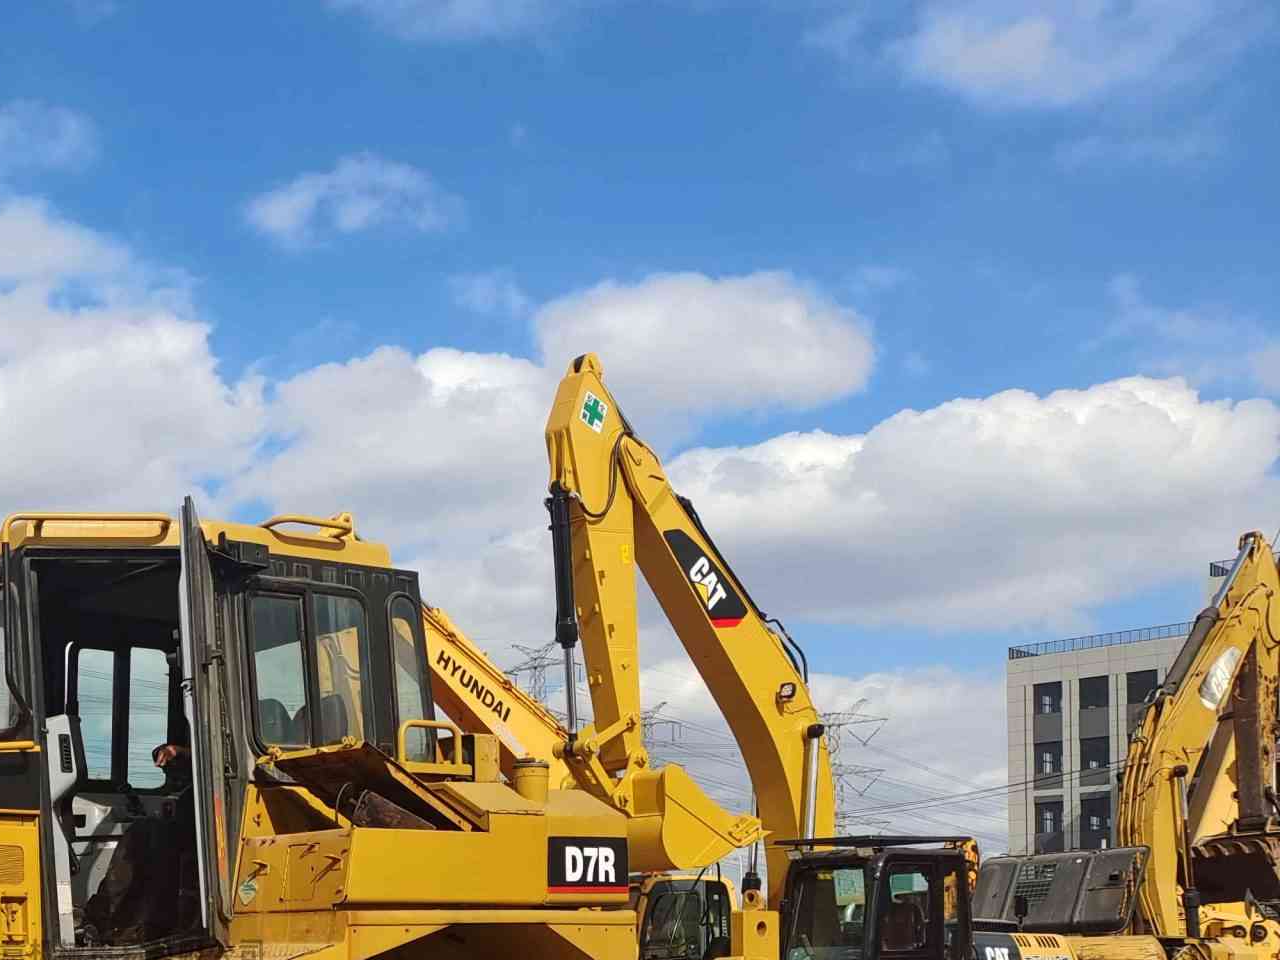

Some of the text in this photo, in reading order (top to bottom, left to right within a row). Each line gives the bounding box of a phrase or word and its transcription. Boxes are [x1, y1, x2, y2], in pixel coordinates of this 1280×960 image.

[688, 556, 728, 610] CAT
[436, 650, 511, 723] HYUNDAI
[564, 846, 616, 884] D7R
